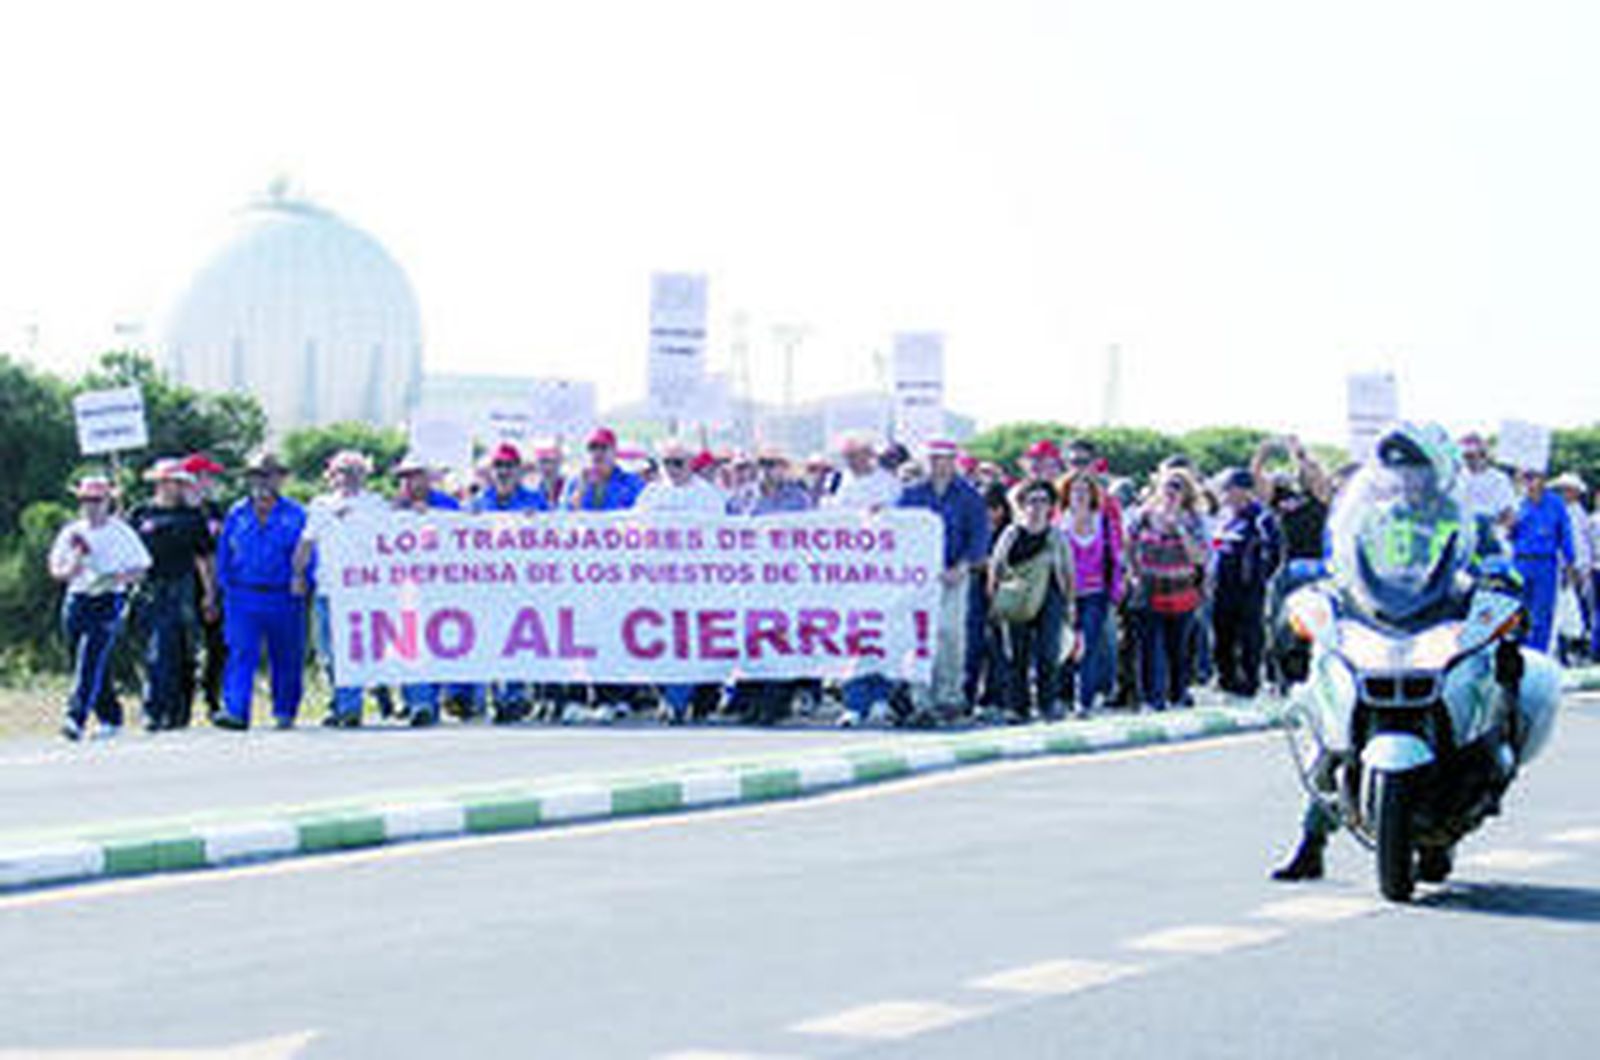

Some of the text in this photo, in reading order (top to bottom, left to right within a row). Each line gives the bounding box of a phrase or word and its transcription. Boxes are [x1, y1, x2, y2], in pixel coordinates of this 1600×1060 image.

[376, 528, 896, 554] LOS TRABAJADORES DE ERCROS
[342, 562, 928, 587] EN DEFENSA DE LOS PUESTOS DE TRABAJO
[502, 606, 597, 660] AL
[621, 607, 886, 660] CIERRE
